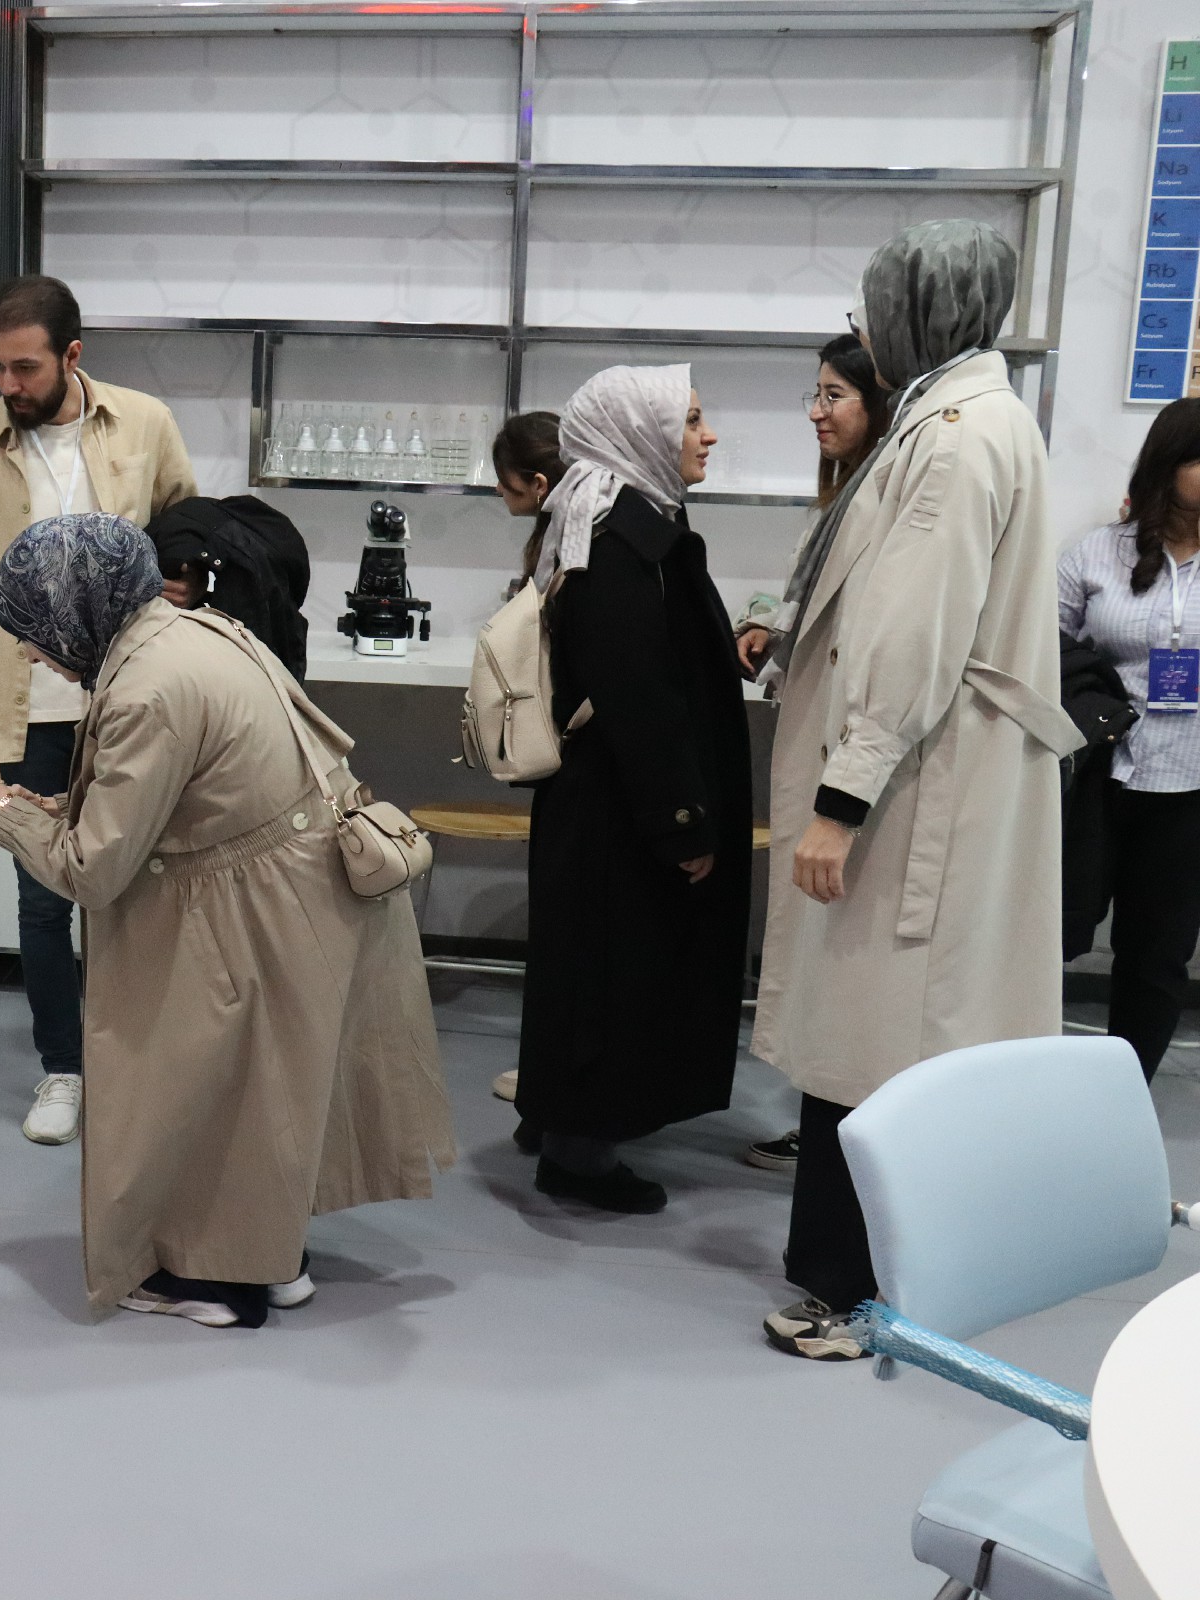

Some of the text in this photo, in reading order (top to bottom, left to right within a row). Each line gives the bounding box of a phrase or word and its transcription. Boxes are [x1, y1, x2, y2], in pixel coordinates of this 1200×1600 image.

[1170, 55, 1188, 70] H
[1158, 160, 1189, 176] Na
[1152, 211, 1168, 226] K
[1147, 262, 1177, 278] Rb
[1141, 313, 1168, 329] Cs
[1135, 364, 1158, 379] Fr
